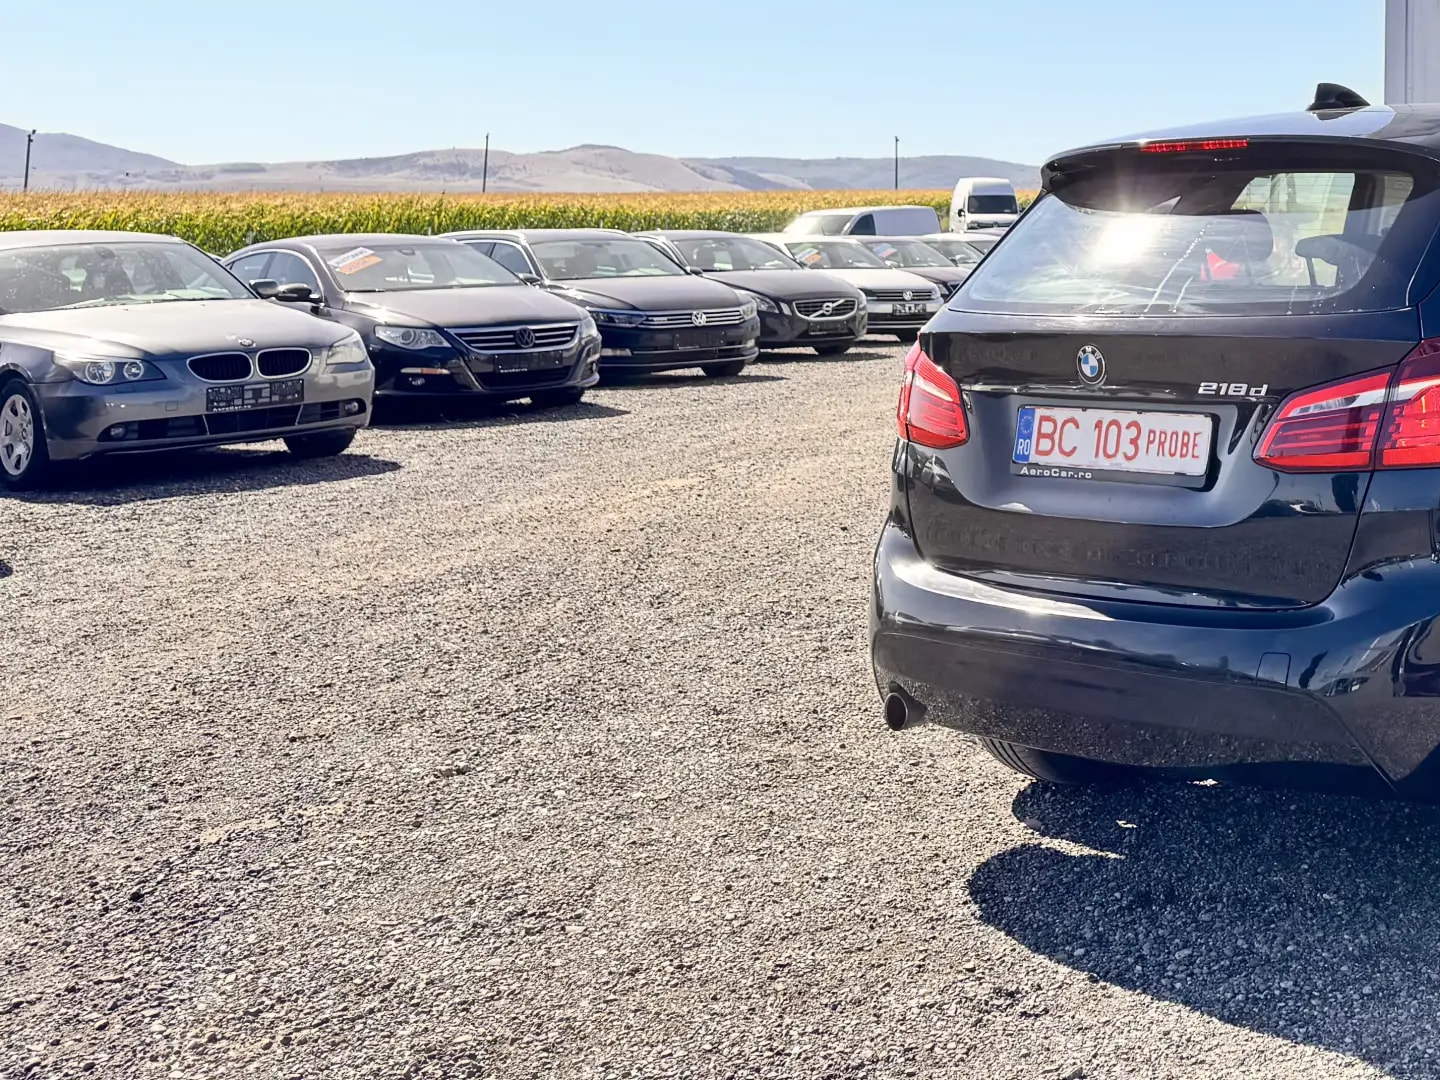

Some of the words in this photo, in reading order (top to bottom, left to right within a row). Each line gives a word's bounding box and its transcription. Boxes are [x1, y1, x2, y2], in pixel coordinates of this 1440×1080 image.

[1198, 382, 1268, 396] 218d
[1034, 415, 1080, 457] BC
[1094, 418, 1142, 461] 103
[1145, 429, 1203, 459] PROBE
[1017, 438, 1031, 455] RO
[1020, 466, 1093, 479] AeroCar.ro
